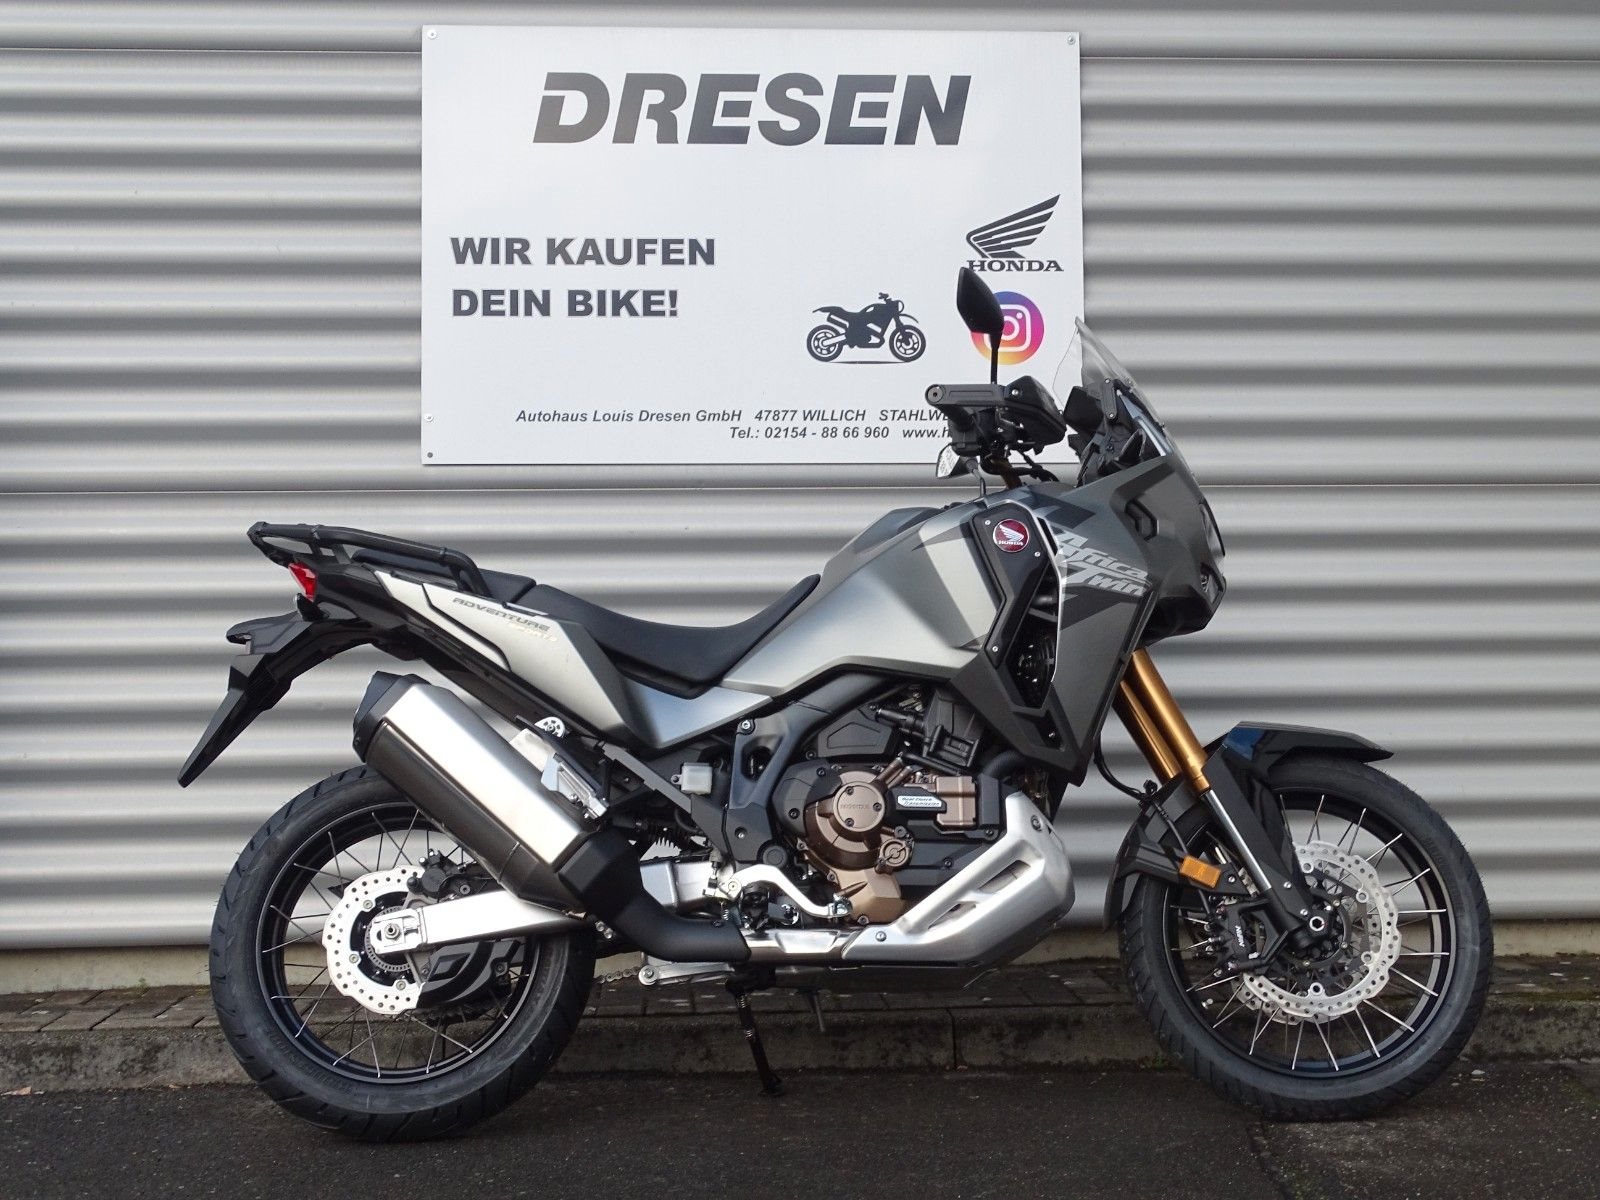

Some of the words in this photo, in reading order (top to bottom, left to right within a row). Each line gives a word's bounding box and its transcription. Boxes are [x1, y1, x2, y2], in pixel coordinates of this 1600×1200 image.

[532, 72, 972, 147] DRESEN
[450, 237, 532, 265] WIR
[546, 237, 715, 266] KAUFEN
[966, 259, 1065, 272] HONDA
[452, 289, 551, 317] DEIN
[567, 289, 679, 317] BIKE!
[515, 410, 588, 422] Autohaus
[593, 410, 634, 422] Louis
[638, 410, 691, 422] Dresen
[695, 410, 742, 422] GmbH
[754, 410, 797, 421] 47877
[802, 409, 867, 422] WILLICH
[729, 427, 759, 439] Tel.:
[764, 427, 807, 439] 02154
[821, 427, 838, 439] 88
[842, 427, 858, 439] 66
[864, 427, 890, 439] 960
[452, 597, 551, 632] ADVENTURE
